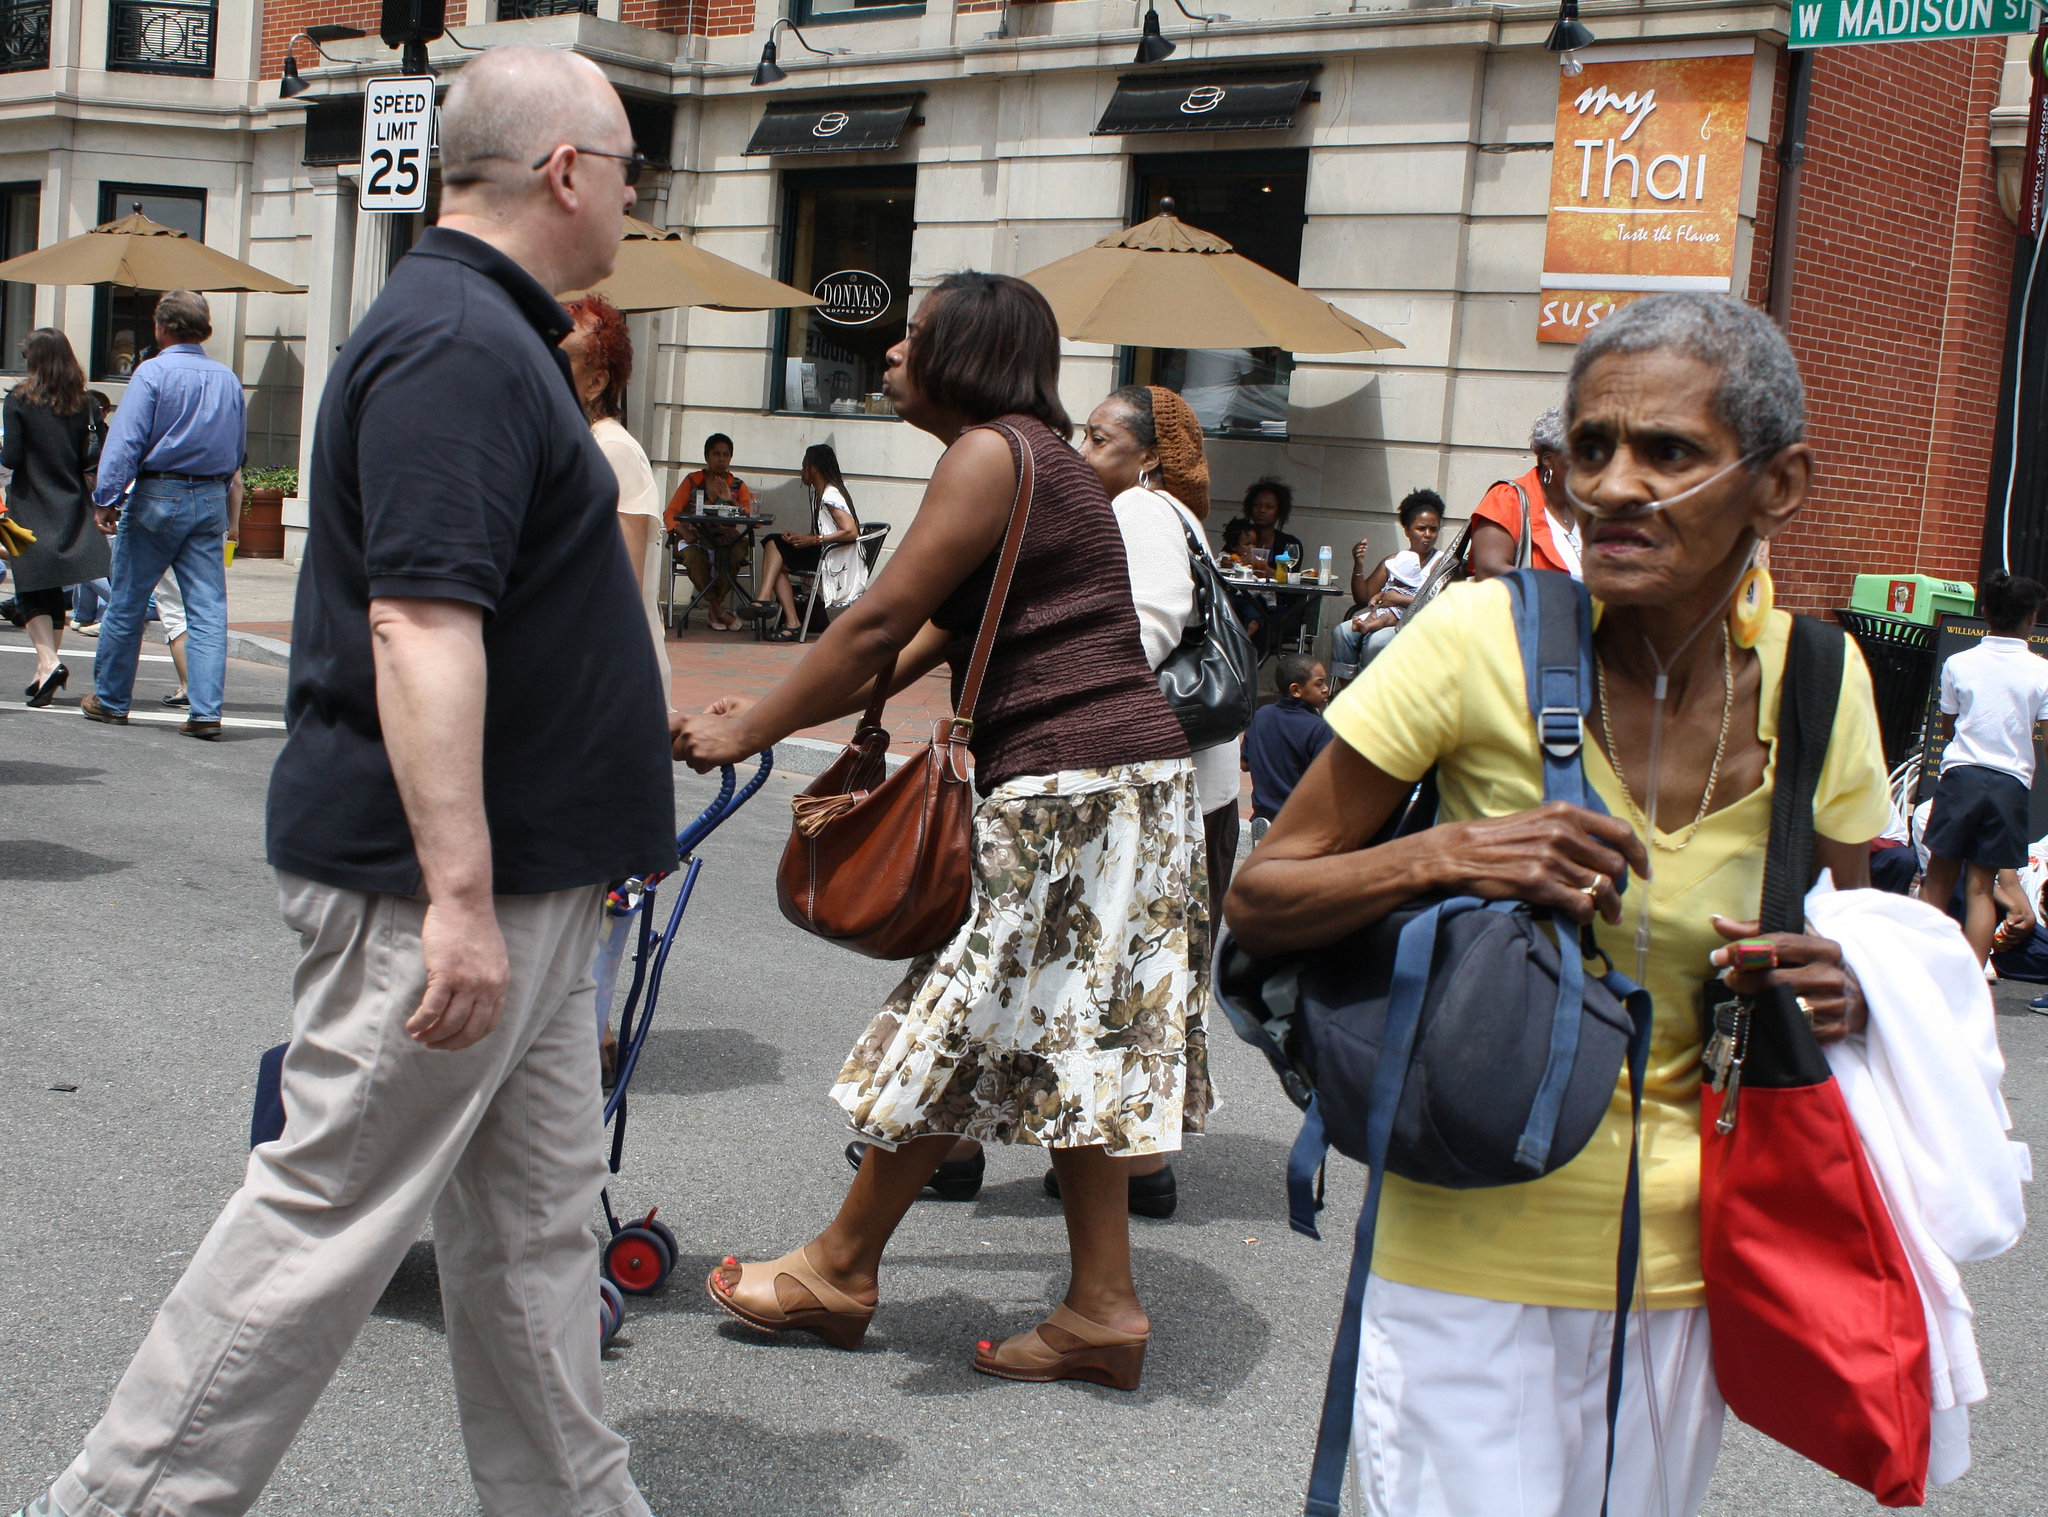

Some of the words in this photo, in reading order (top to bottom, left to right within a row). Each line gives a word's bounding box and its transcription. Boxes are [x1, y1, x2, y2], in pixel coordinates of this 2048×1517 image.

[1798, 4, 1823, 38] W
[1837, 0, 1993, 38] MADISON
[373, 93, 426, 115] SPEED
[1574, 85, 1658, 142] my
[376, 121, 418, 141] LIMIT
[367, 148, 419, 195] 25
[1574, 138, 1707, 201] Thai
[2031, 169, 2041, 232] MOUNT
[2037, 98, 2048, 165] VERNON
[1617, 223, 1648, 242] Taste
[1651, 224, 1673, 242] the
[1675, 224, 1721, 243] Flavor
[823, 283, 882, 308] DONNA'S
[1943, 582, 1962, 593] FREE
[1946, 625, 1984, 637] WILLIAM
